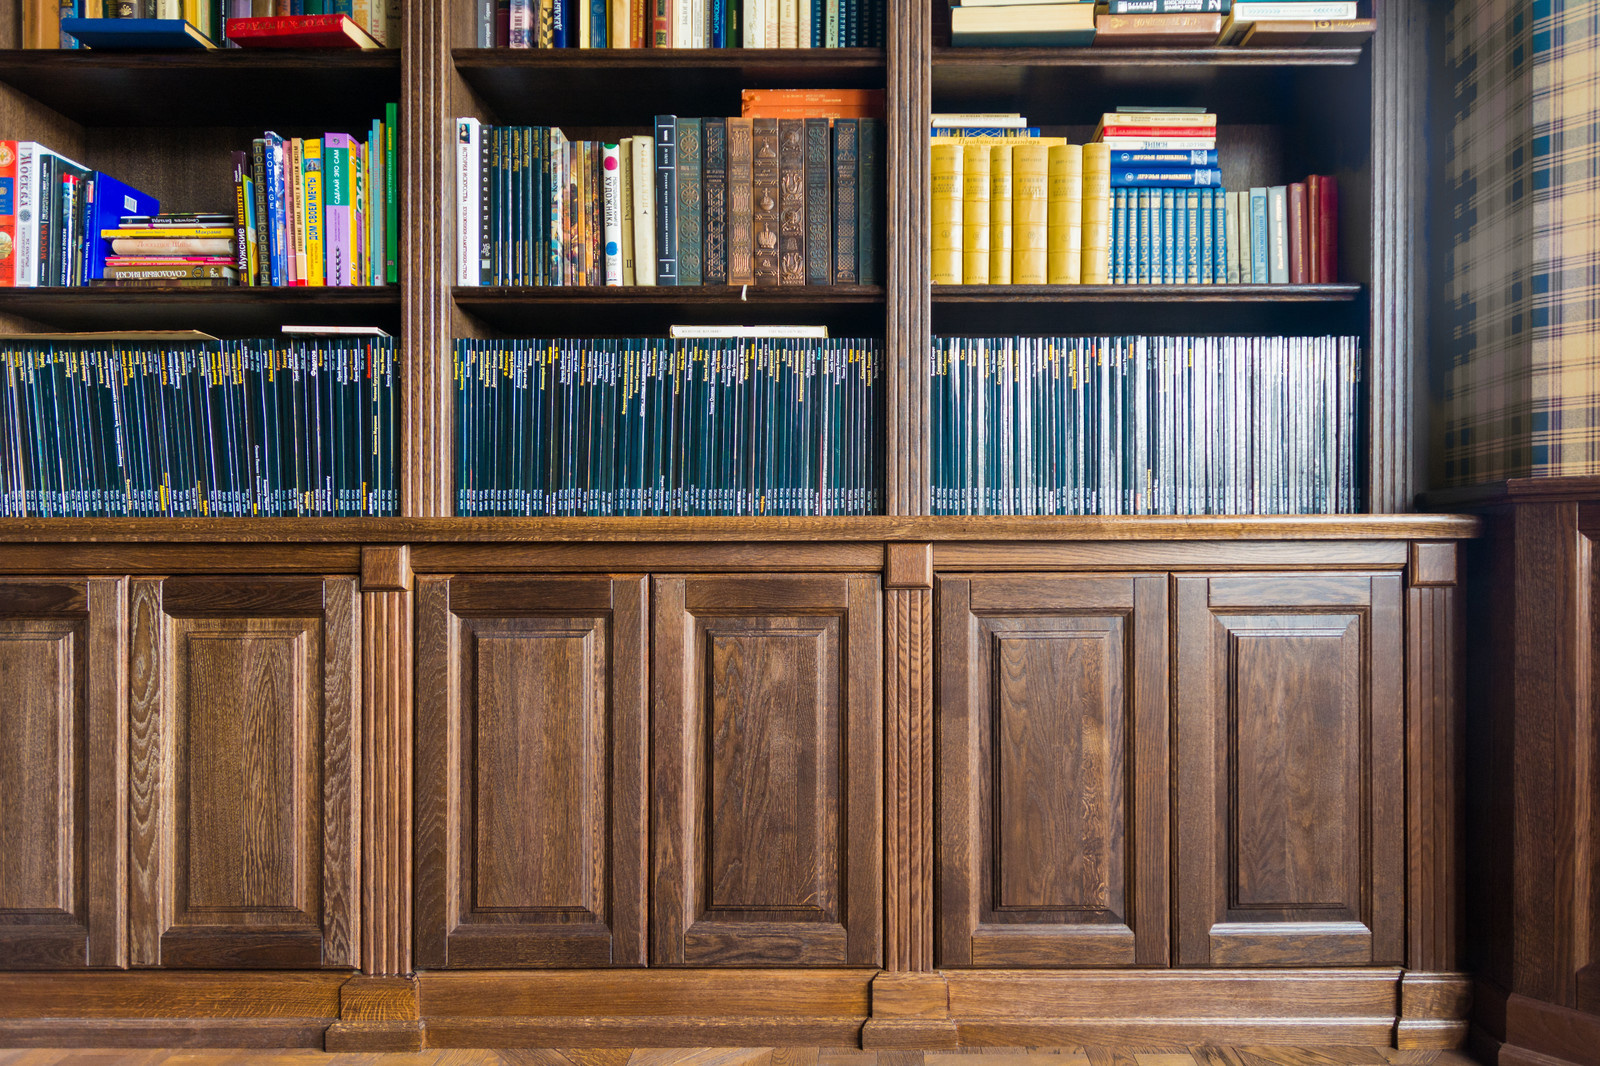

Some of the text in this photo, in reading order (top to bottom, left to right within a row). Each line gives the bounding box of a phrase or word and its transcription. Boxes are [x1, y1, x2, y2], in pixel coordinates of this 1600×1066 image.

[266, 152, 275, 209] COTTAGE
[308, 177, 319, 240] ДОМ СВОЕЙ МЕЧТЫ
[605, 176, 613, 227] ХУДОЖНИКА
[236, 185, 248, 270] Мужские напитки
[141, 270, 187, 278] СОЛОДОВЫЙ
